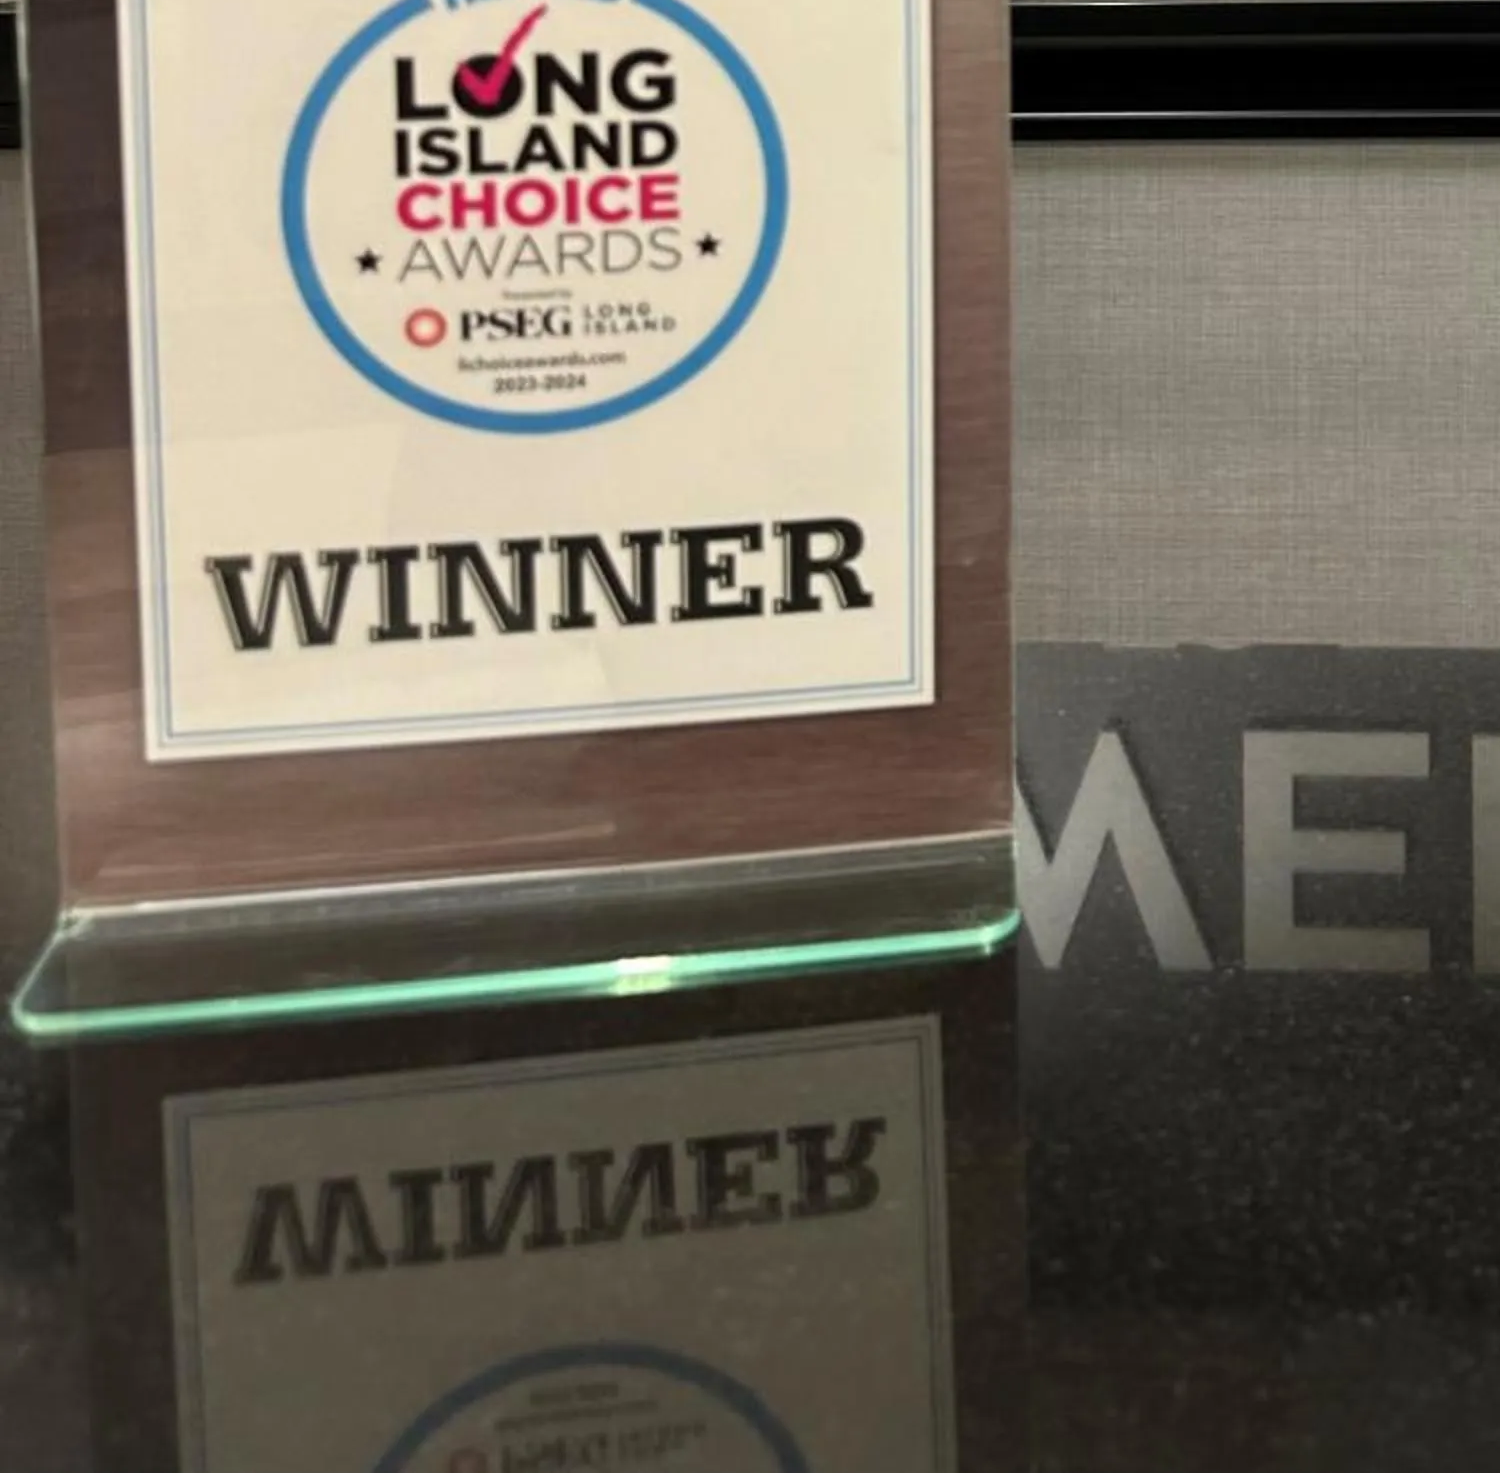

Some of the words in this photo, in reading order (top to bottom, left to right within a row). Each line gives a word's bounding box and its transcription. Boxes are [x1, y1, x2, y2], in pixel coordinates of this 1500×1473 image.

[395, 48, 677, 121] LONG
[395, 120, 679, 177] ISLAND
[396, 172, 682, 233] CHOICE
[397, 226, 684, 284] AWARDS
[460, 304, 572, 342] PSEG
[584, 302, 652, 319] LONG
[584, 316, 677, 335] ISLAND
[494, 373, 586, 394] 2023-2024
[203, 517, 874, 651] WINNER
